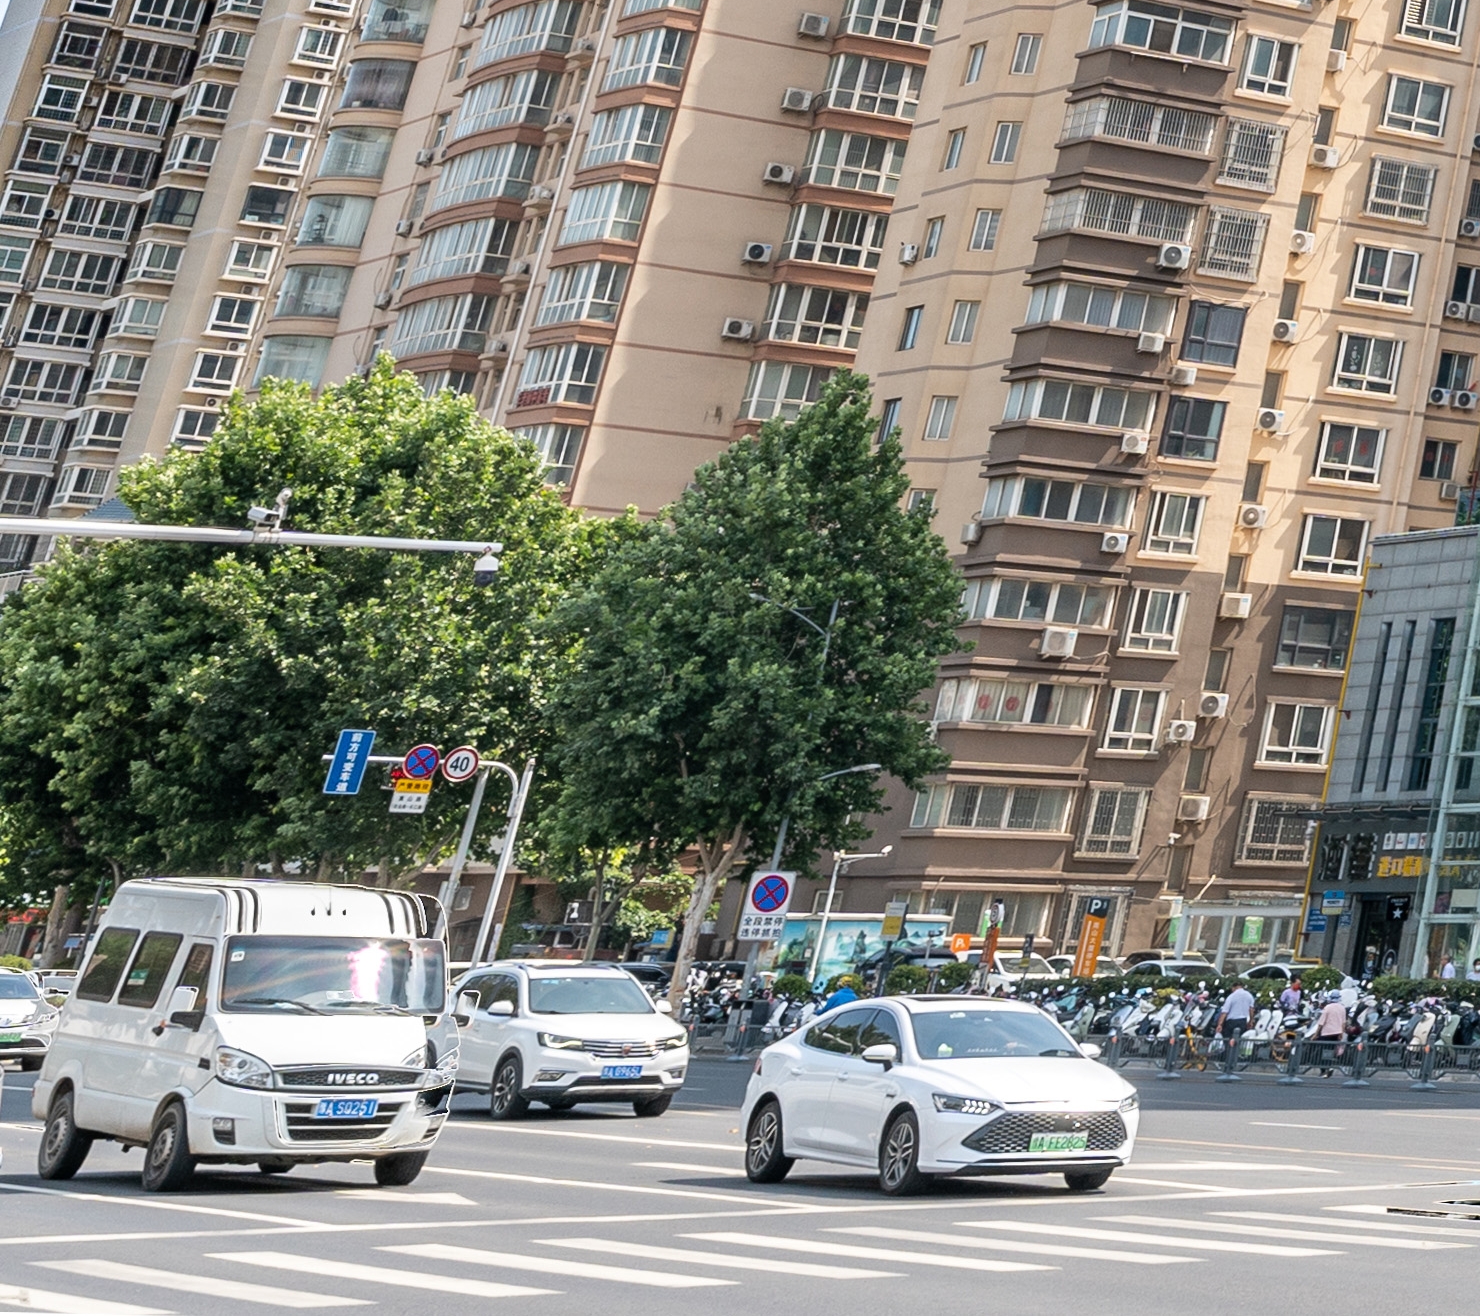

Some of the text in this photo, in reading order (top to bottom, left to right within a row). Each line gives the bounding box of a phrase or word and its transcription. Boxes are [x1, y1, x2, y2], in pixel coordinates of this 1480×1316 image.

[335, 732, 364, 793] 前方可变车道
[450, 756, 470, 773] 40
[1090, 899, 1102, 914] P
[742, 916, 783, 927] 全段禁停
[740, 927, 782, 939] 违停抓拍
[326, 1072, 380, 1085] IVECO
